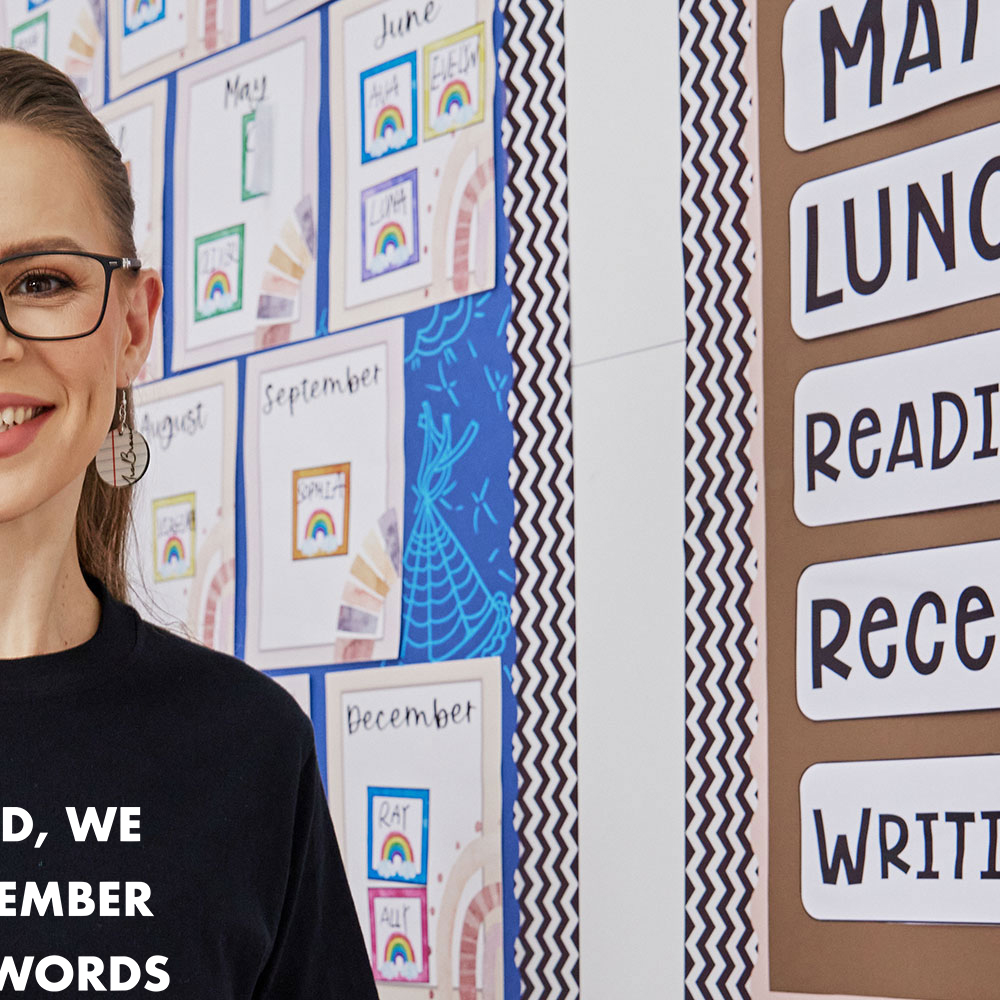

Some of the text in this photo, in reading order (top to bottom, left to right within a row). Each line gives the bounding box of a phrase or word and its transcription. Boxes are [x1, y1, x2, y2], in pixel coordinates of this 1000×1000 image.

[374, 1, 435, 50] June
[224, 74, 267, 110] May
[262, 363, 382, 415] September
[139, 403, 207, 450] August
[346, 699, 476, 735] December
[66, 807, 140, 841] WE
